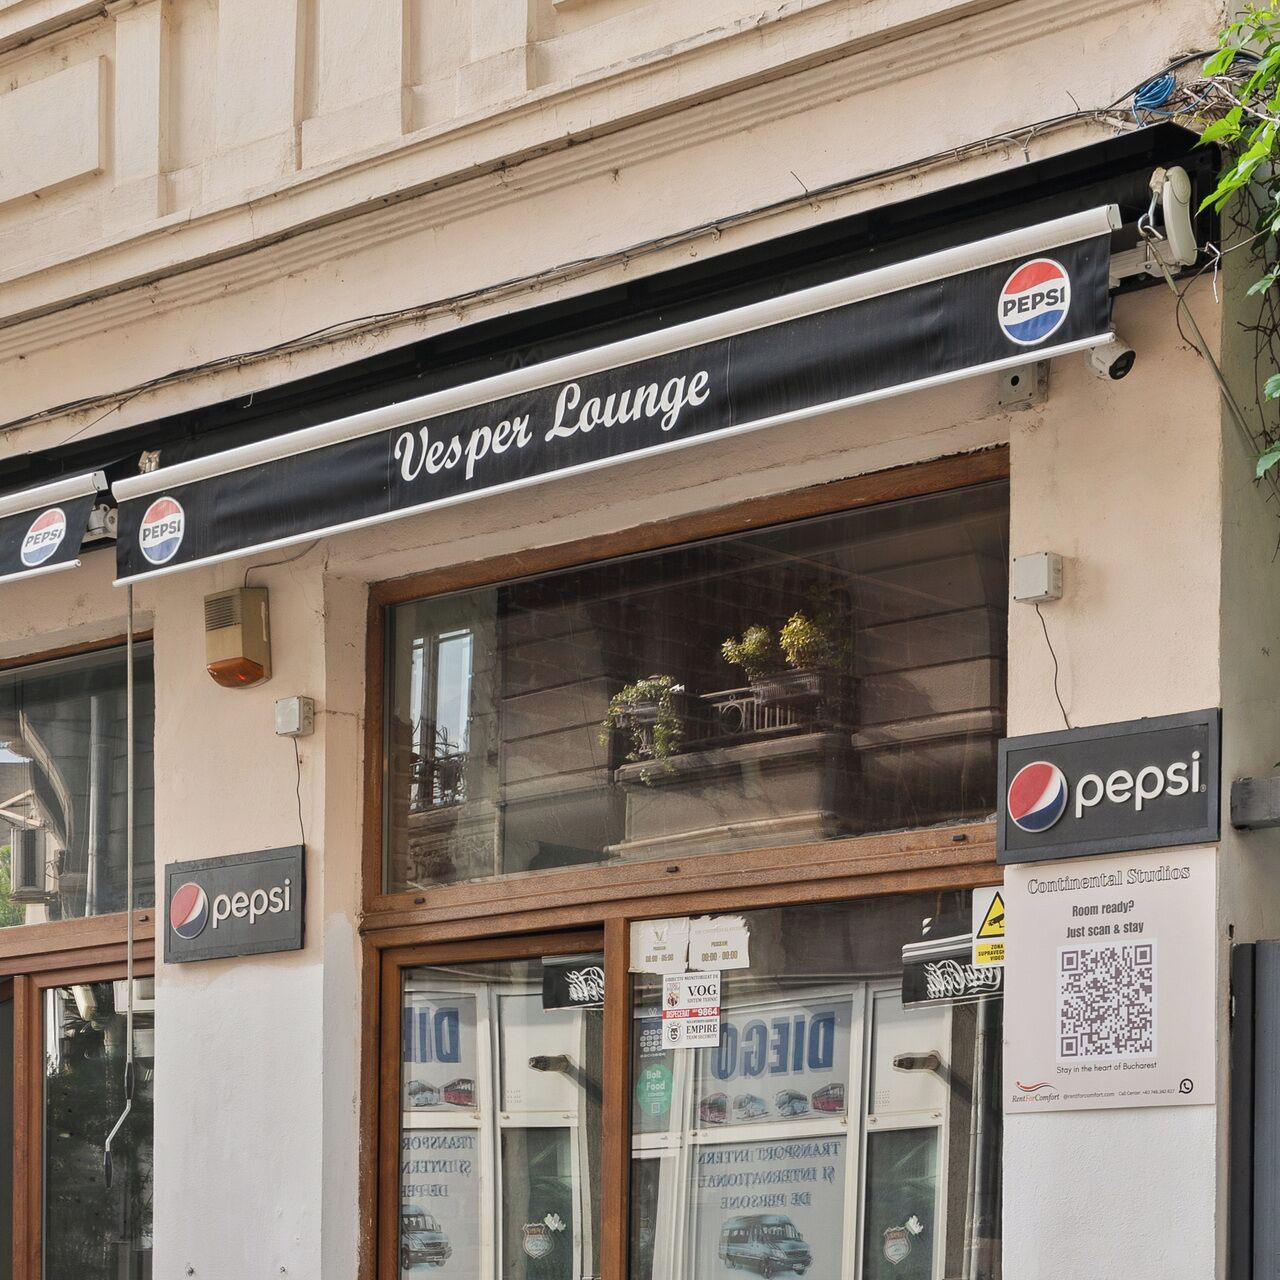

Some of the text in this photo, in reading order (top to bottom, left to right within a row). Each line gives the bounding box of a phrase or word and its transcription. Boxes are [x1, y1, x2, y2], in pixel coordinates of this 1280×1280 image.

[1002, 286, 1065, 318] PEPSI
[394, 370, 711, 482] Vesper Lounge
[25, 528, 63, 548] PEPSI
[142, 519, 181, 542] PEPSI
[1075, 750, 1201, 819] pepsi
[1027, 863, 1191, 896] Continental Studios
[212, 878, 292, 929] pepsi
[1072, 899, 1135, 918] Room ready?
[1066, 920, 1144, 939] Just scan & stay
[697, 1007, 718, 1016] 9864
[686, 1023, 718, 1035] EMPIRE
[646, 1069, 662, 1080] Bolt
[1056, 1061, 1157, 1075] Stay in the heart of Bucharest
[646, 1081, 666, 1091] Food
